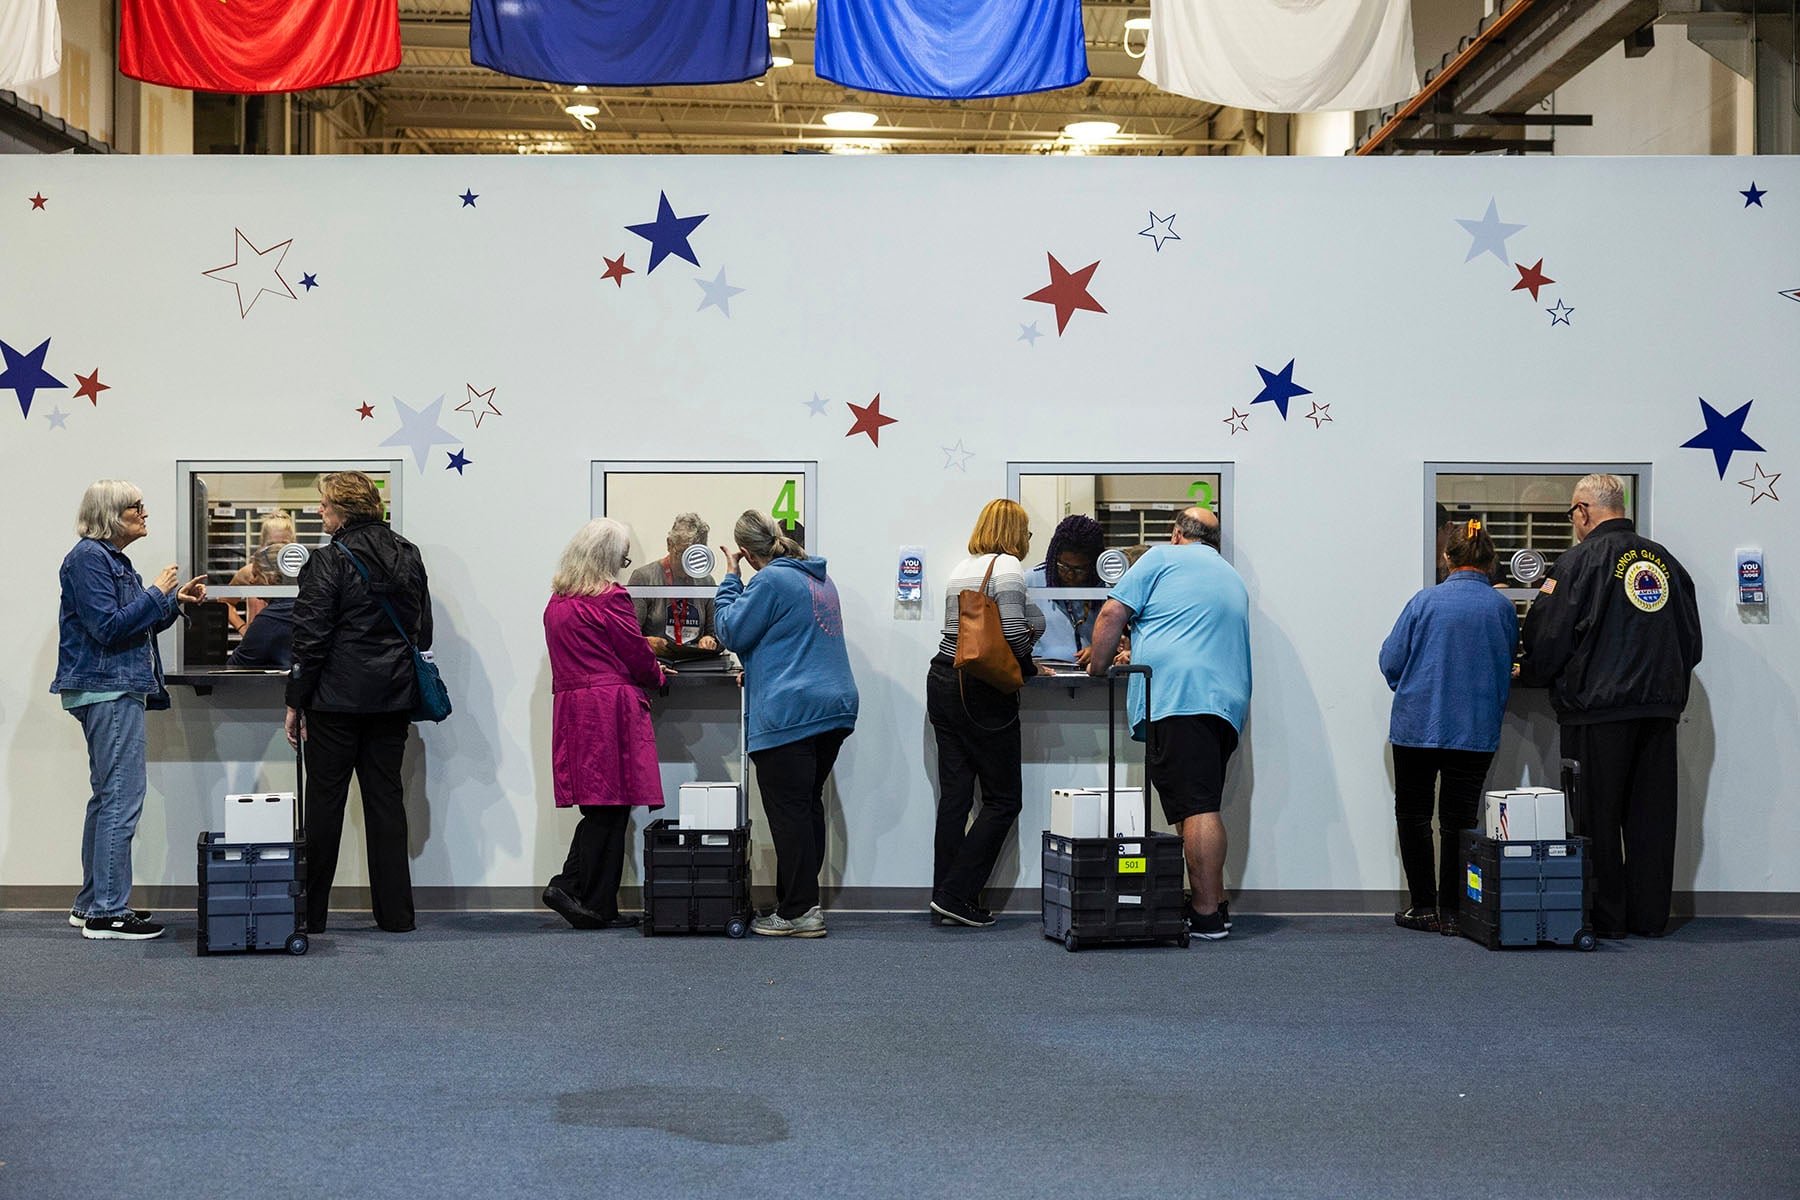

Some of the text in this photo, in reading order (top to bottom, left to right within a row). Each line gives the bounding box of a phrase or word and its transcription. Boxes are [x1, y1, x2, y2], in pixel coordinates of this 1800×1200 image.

[771, 479, 800, 531] 4
[1614, 549, 1639, 579] HONOR
[1640, 549, 1671, 580] GUARD
[1125, 861, 1139, 869] 501
